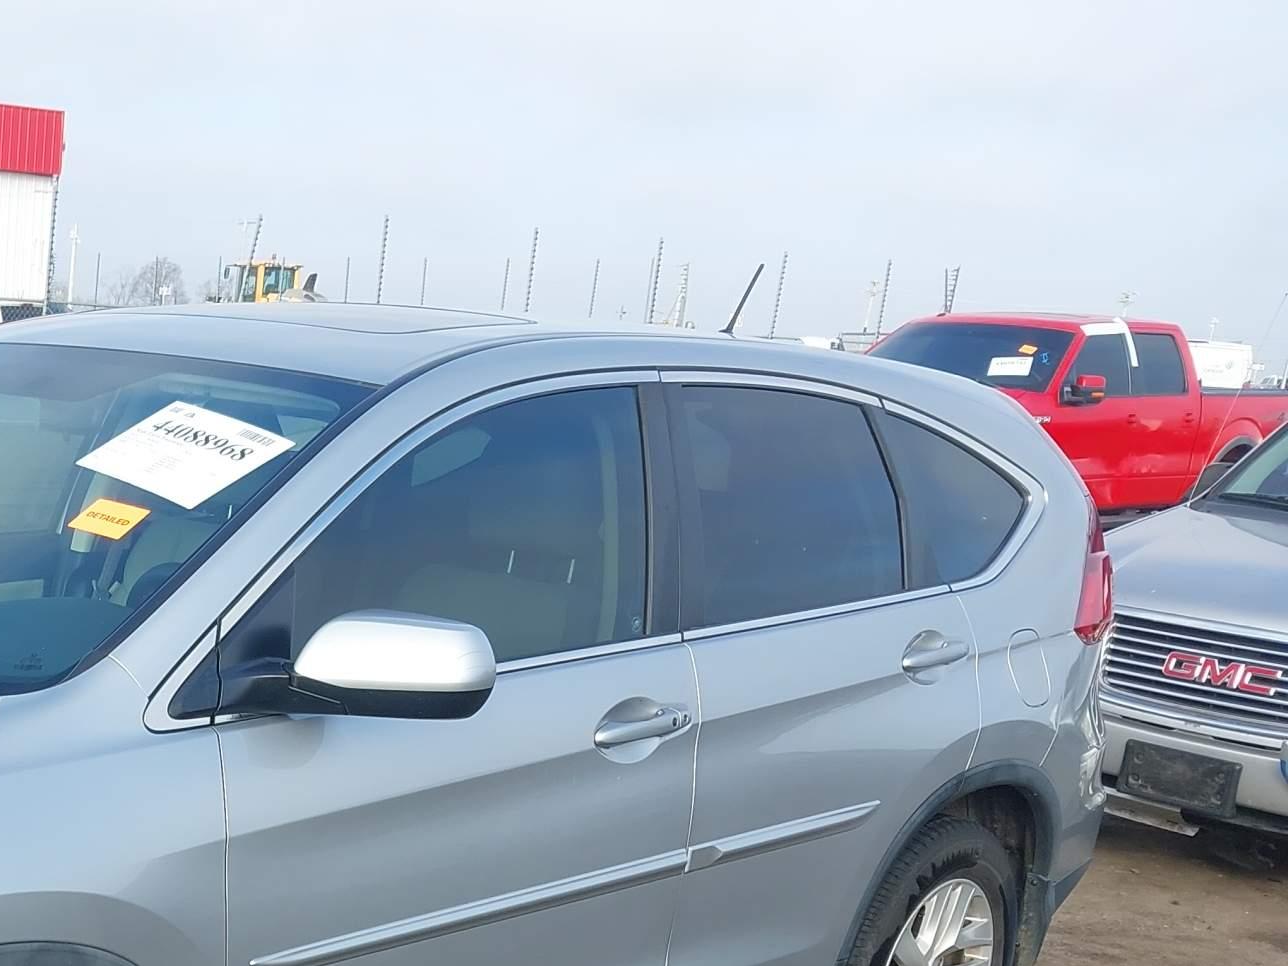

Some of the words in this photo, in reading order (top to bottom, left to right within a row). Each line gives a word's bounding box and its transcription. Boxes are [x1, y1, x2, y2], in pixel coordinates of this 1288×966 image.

[152, 420, 254, 461] 44088968
[86, 511, 130, 526] DETAILED
[1162, 651, 1282, 696] GMC
